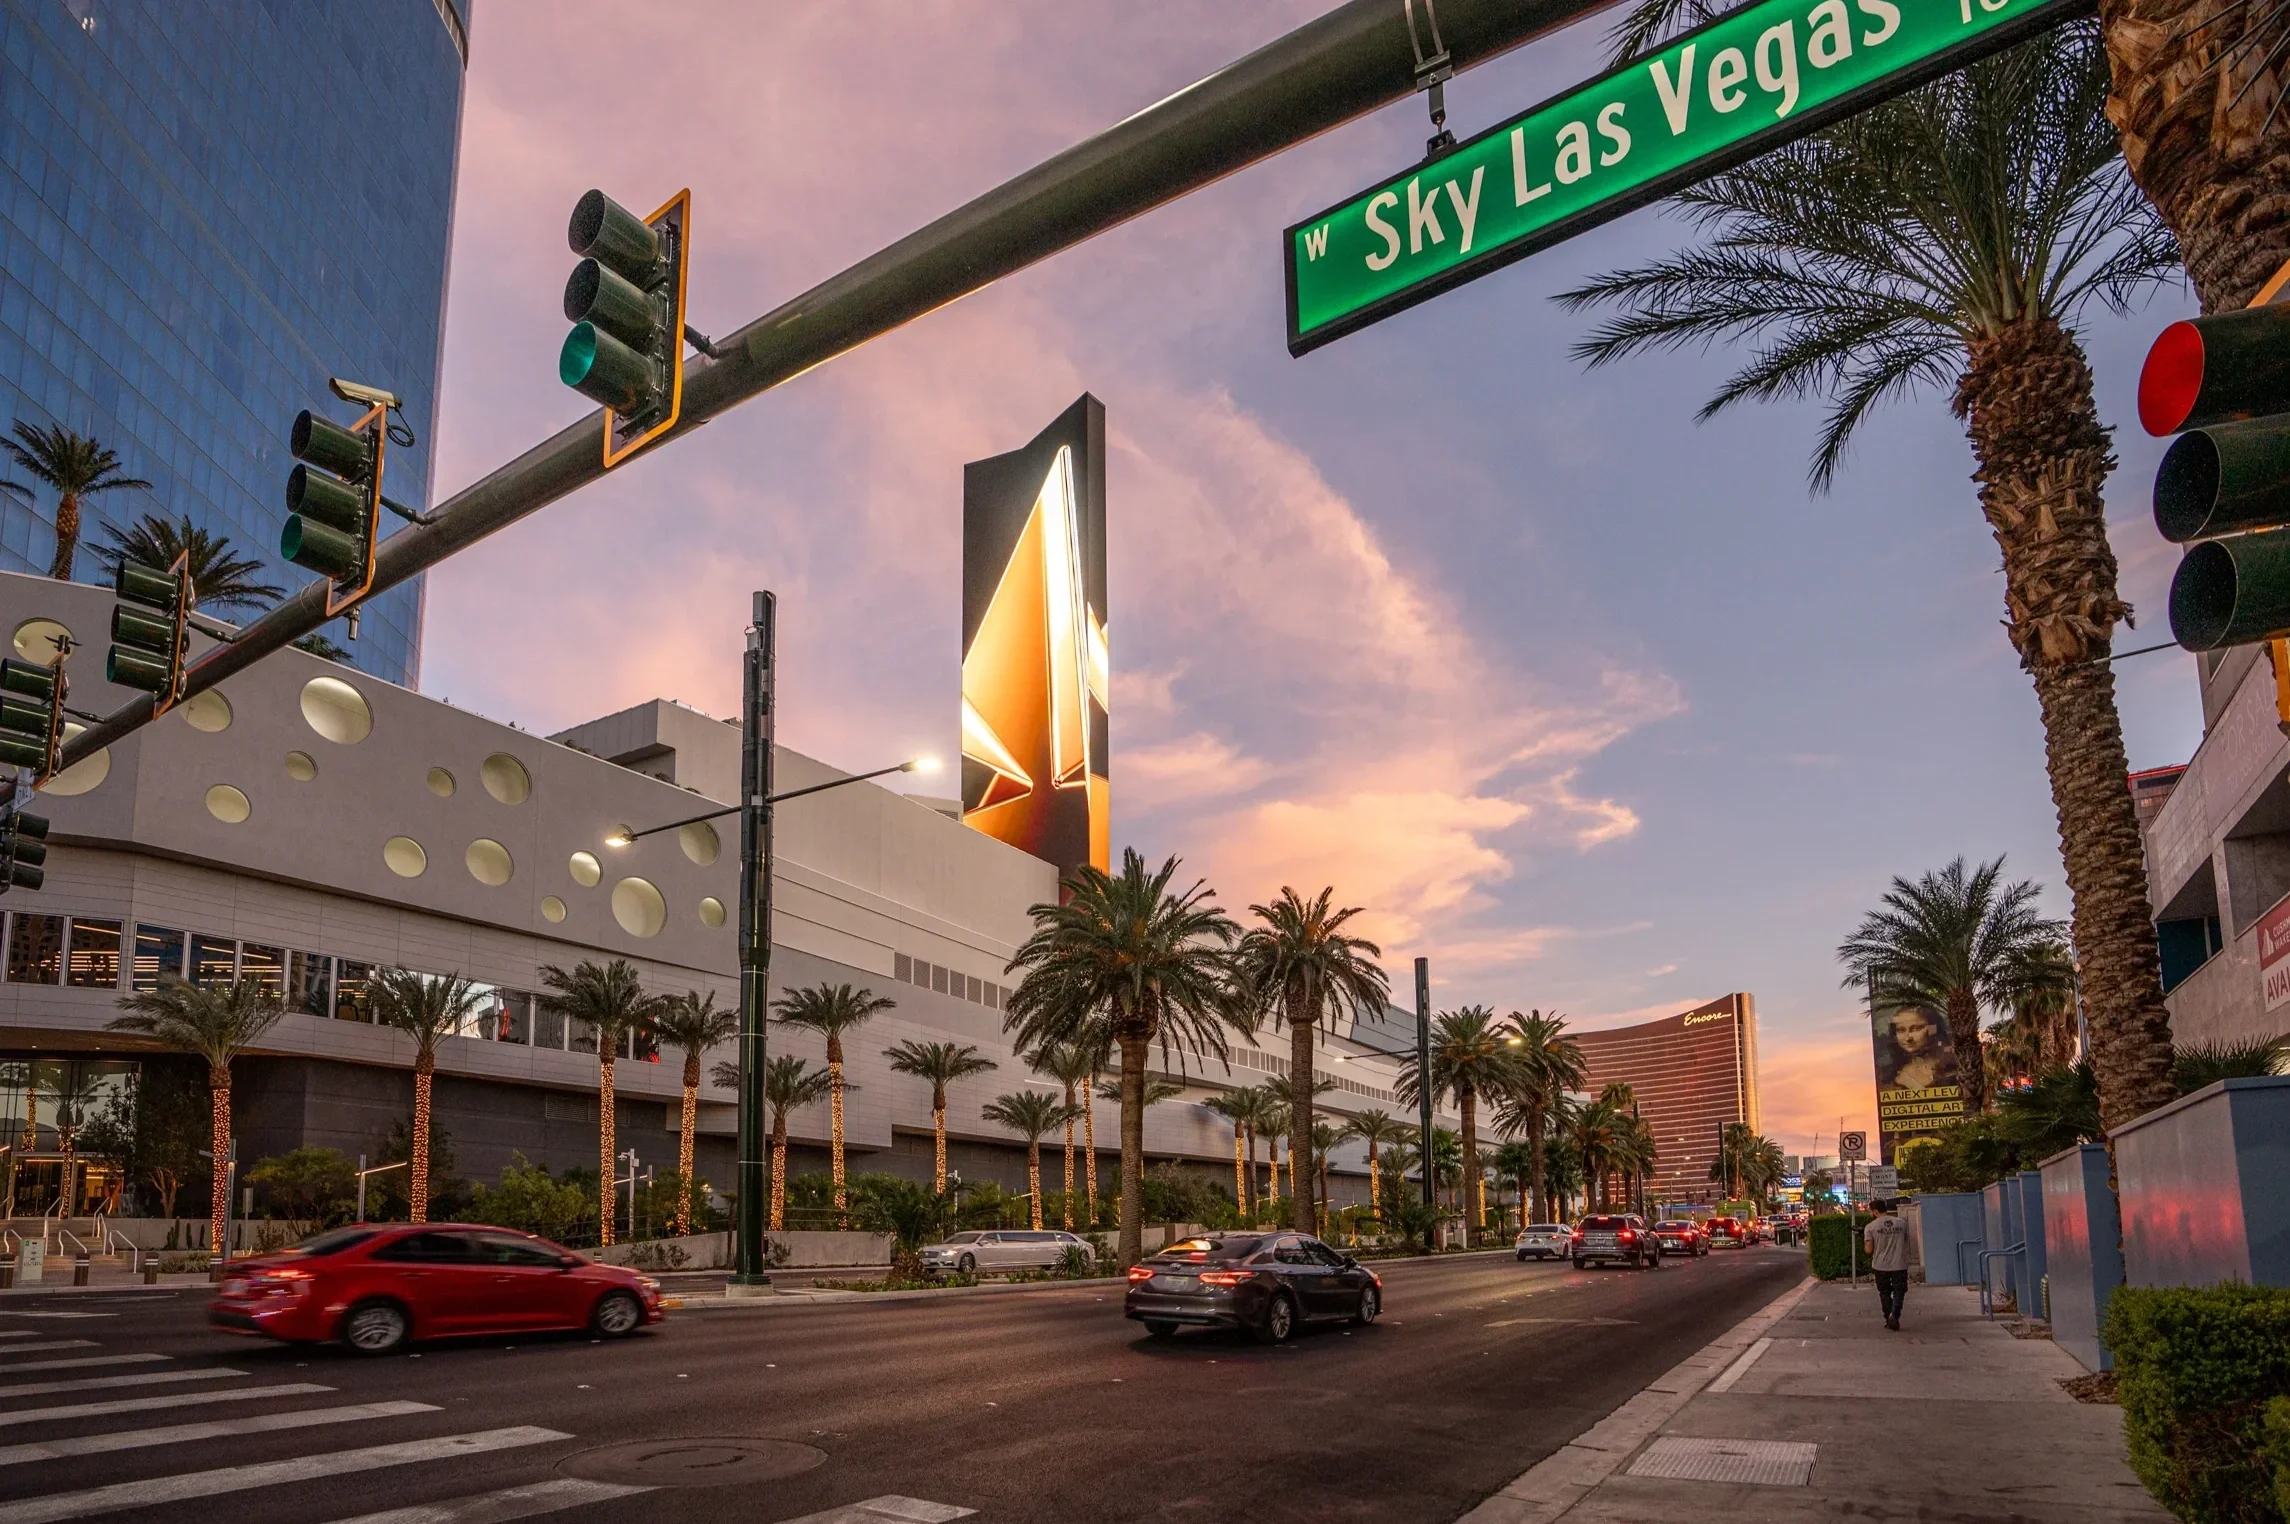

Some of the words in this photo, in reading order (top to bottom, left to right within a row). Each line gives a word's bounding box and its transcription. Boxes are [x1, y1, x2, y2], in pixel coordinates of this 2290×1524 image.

[1304, 223, 1329, 262] W
[1365, 165, 1485, 271] Sky
[1510, 102, 1632, 208] Las
[1648, 0, 1901, 137] Vegas
[2274, 930, 2290, 951] WAKE
[2267, 966, 2290, 1005] AVAI
[1683, 1011, 1732, 1026] Encore
[1882, 1092, 1891, 1101] A
[1895, 1089, 1929, 1100] NEXT
[1934, 1086, 1960, 1097] LEV
[1883, 1104, 1939, 1116] DIGITAL
[1884, 1117, 1964, 1131] EXPERIENC
